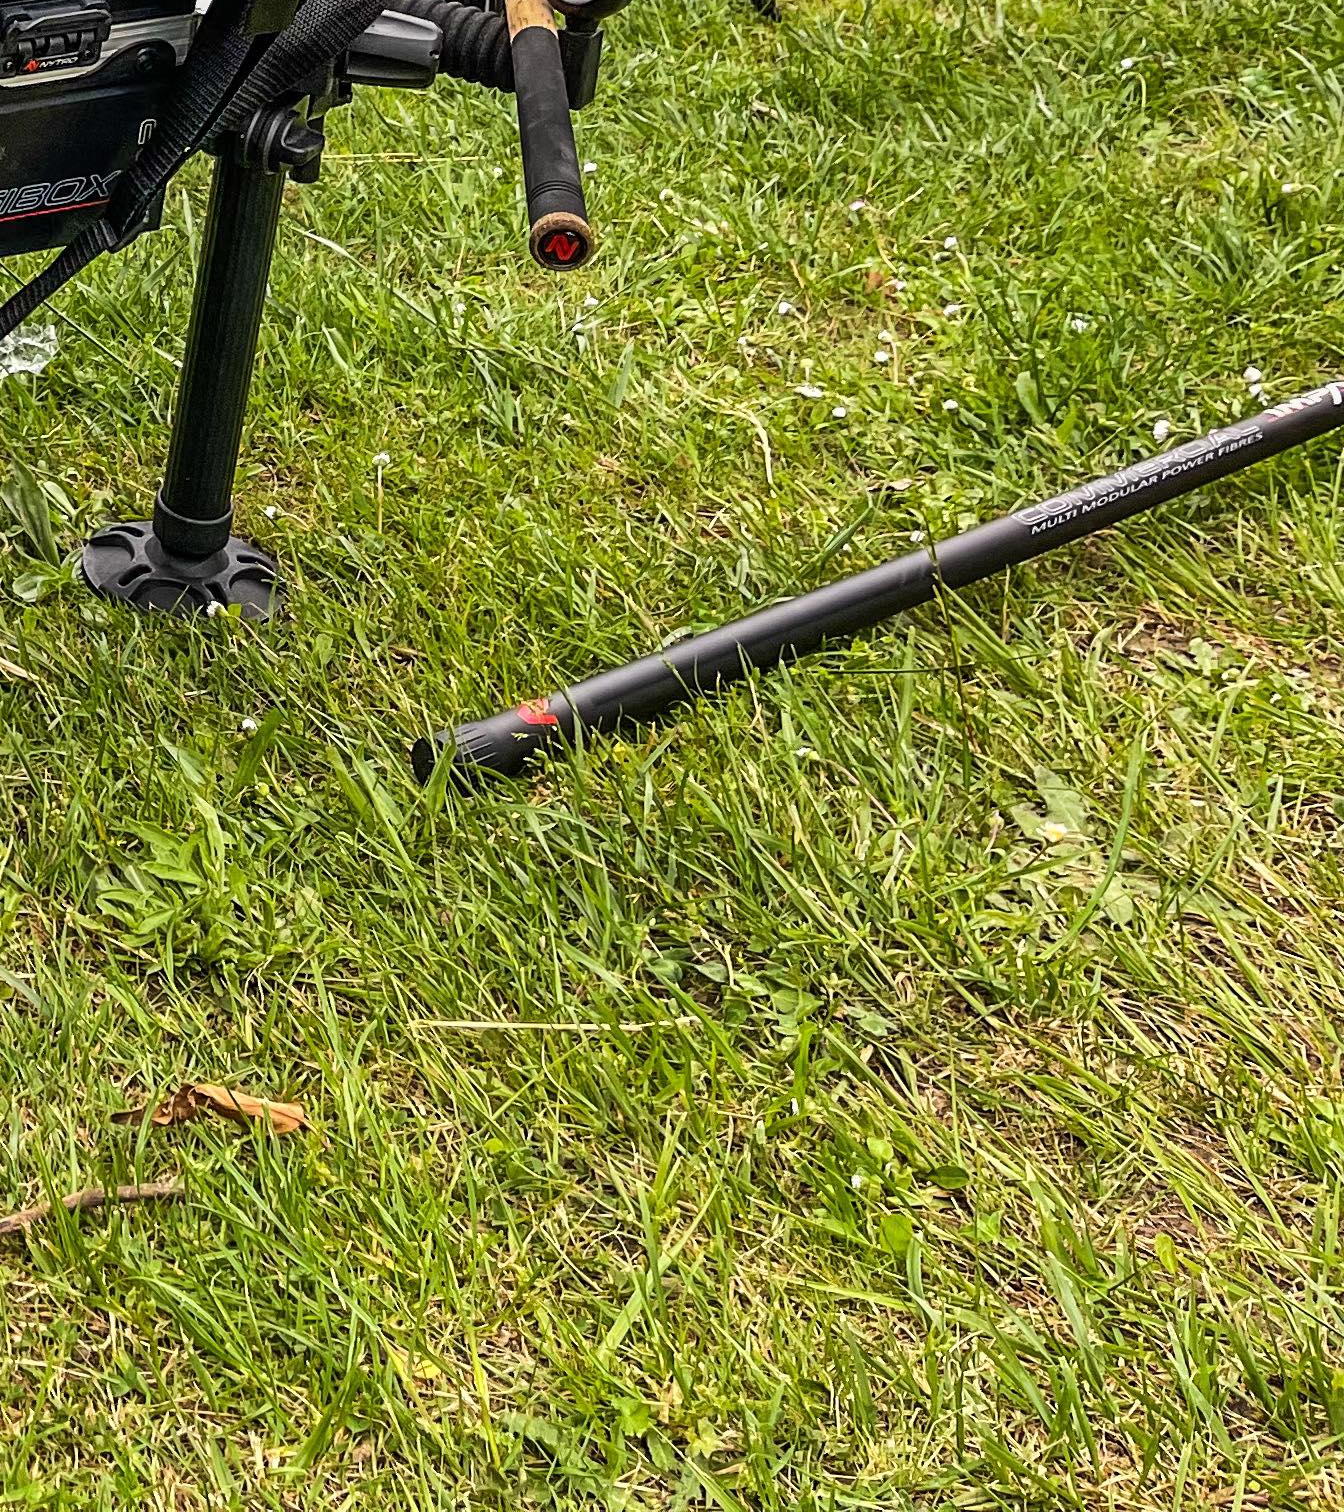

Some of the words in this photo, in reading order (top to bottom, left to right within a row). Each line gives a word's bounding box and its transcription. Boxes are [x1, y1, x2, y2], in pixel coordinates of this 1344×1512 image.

[1031, 509, 1078, 536] MULTI
[1081, 476, 1159, 514] MODULAR
[1161, 451, 1214, 480] POWER
[1218, 431, 1263, 457] FIBRES
